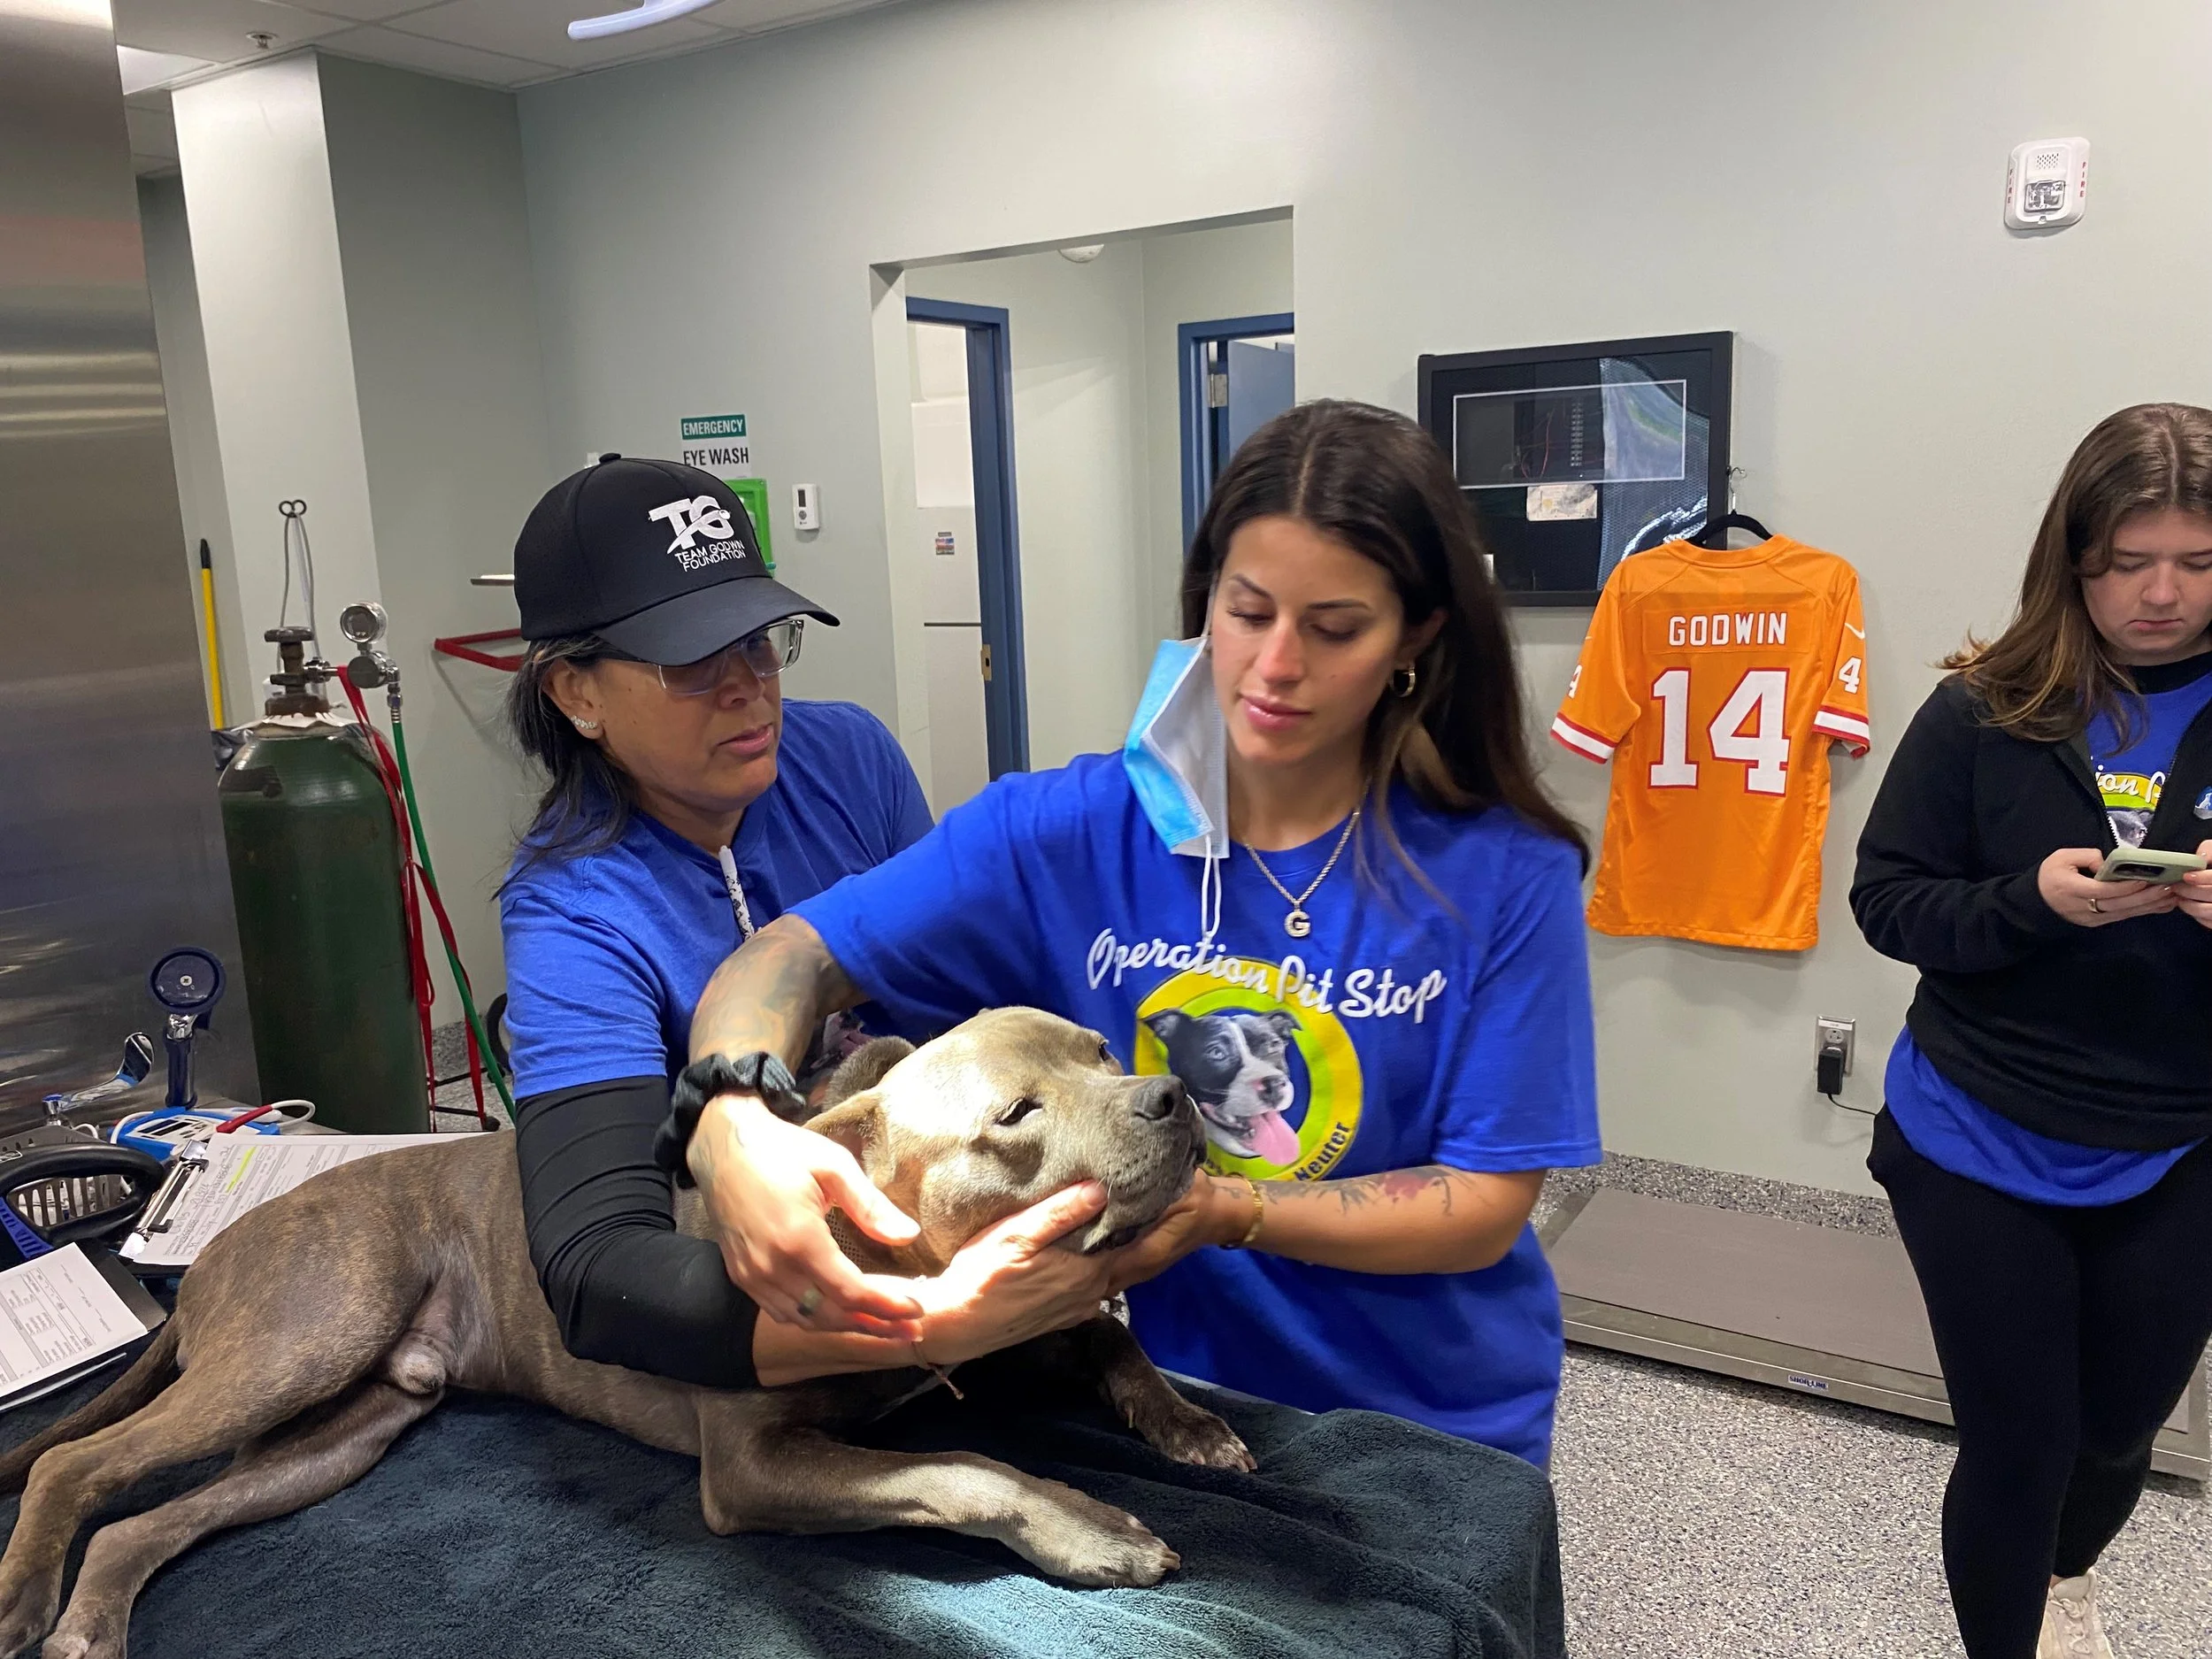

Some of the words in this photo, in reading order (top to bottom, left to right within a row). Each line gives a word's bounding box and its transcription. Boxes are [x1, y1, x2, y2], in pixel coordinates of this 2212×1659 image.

[683, 419, 742, 436] EMERGENCY
[683, 449, 706, 466] EYE
[709, 447, 749, 465] WASH
[674, 546, 708, 564] TEAM
[682, 549, 746, 572] FOUNDATION
[1669, 612, 1788, 647] GODWIN
[1837, 656, 1863, 695] 4
[1647, 666, 1791, 798] 14
[1284, 911, 1311, 938] G
[1087, 927, 1269, 994] Operation
[1276, 955, 1333, 1014] Pit
[1338, 968, 1448, 1025] Stop
